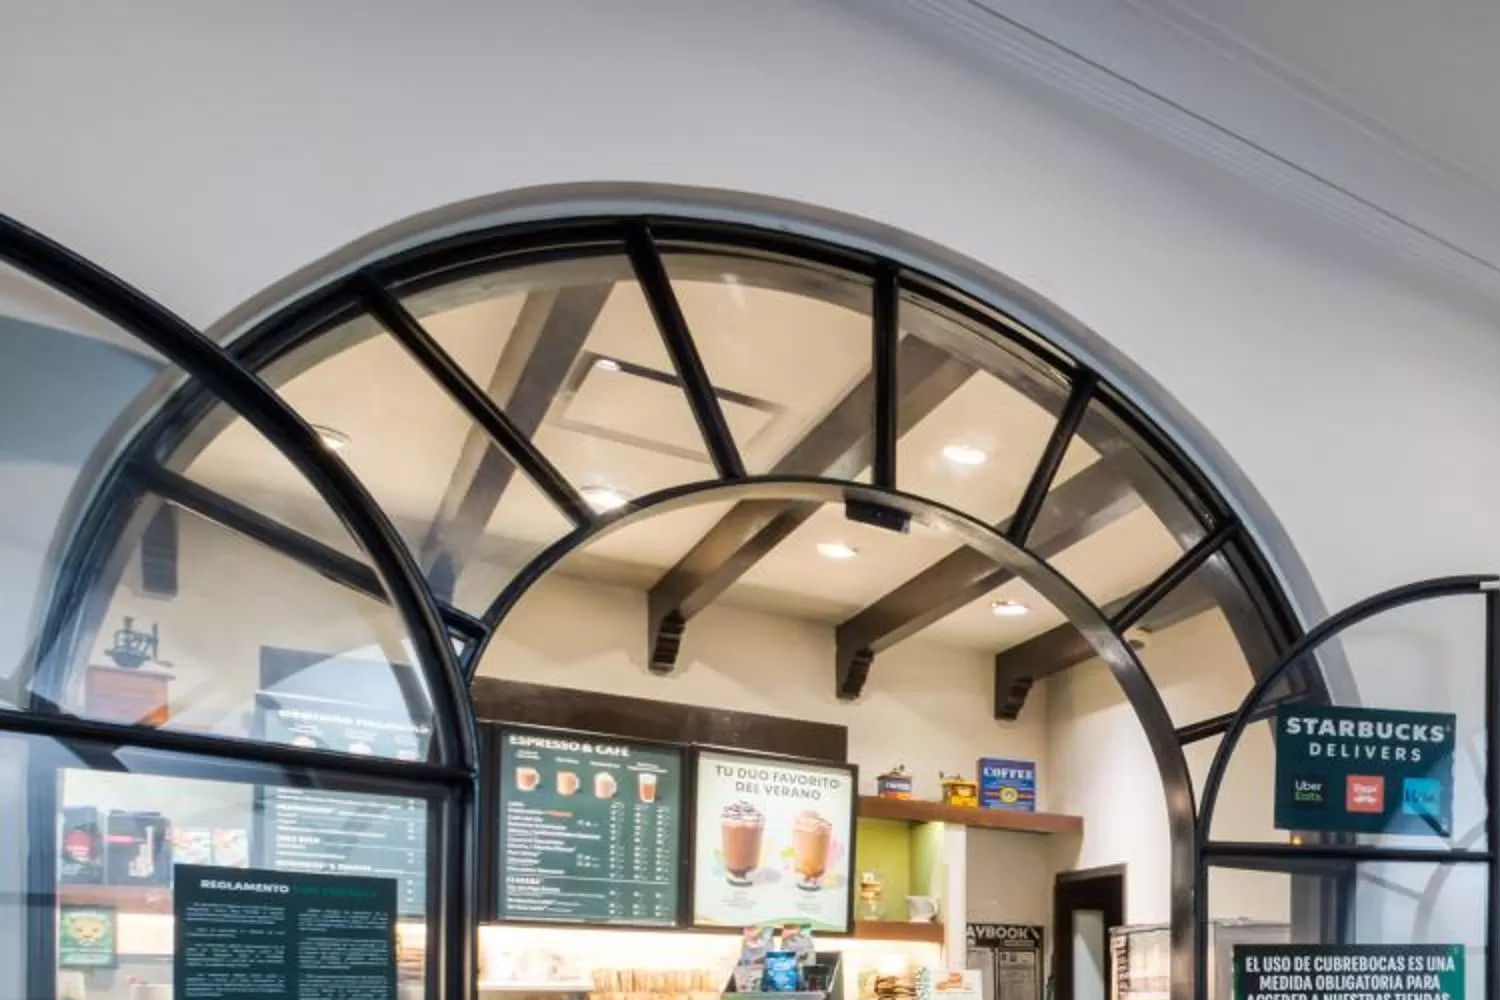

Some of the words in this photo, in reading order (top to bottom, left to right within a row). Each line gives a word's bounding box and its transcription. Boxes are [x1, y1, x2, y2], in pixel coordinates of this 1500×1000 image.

[1286, 717, 1445, 743] STARBUCKS
[1309, 742, 1422, 762] DELIVERS
[715, 764, 734, 777] TU
[737, 767, 769, 780] DUO
[773, 771, 841, 789] FAVORITO
[735, 781, 760, 793] DEL
[764, 785, 822, 801] VERANO
[1295, 780, 1323, 791] Uber
[200, 878, 290, 894] REGLAMENTO
[966, 925, 1028, 939] AYBOOK
[1245, 956, 1260, 973] EL
[1263, 956, 1291, 972] USO
[1293, 956, 1312, 972] DE
[1313, 956, 1406, 972] CUBREBOCAS
[1407, 956, 1424, 972] ES
[1427, 956, 1455, 972] UNA
[1259, 975, 1312, 991] MEDIDA
[1315, 975, 1403, 991] OBLIGATORIA
[1407, 975, 1440, 991] PARA
